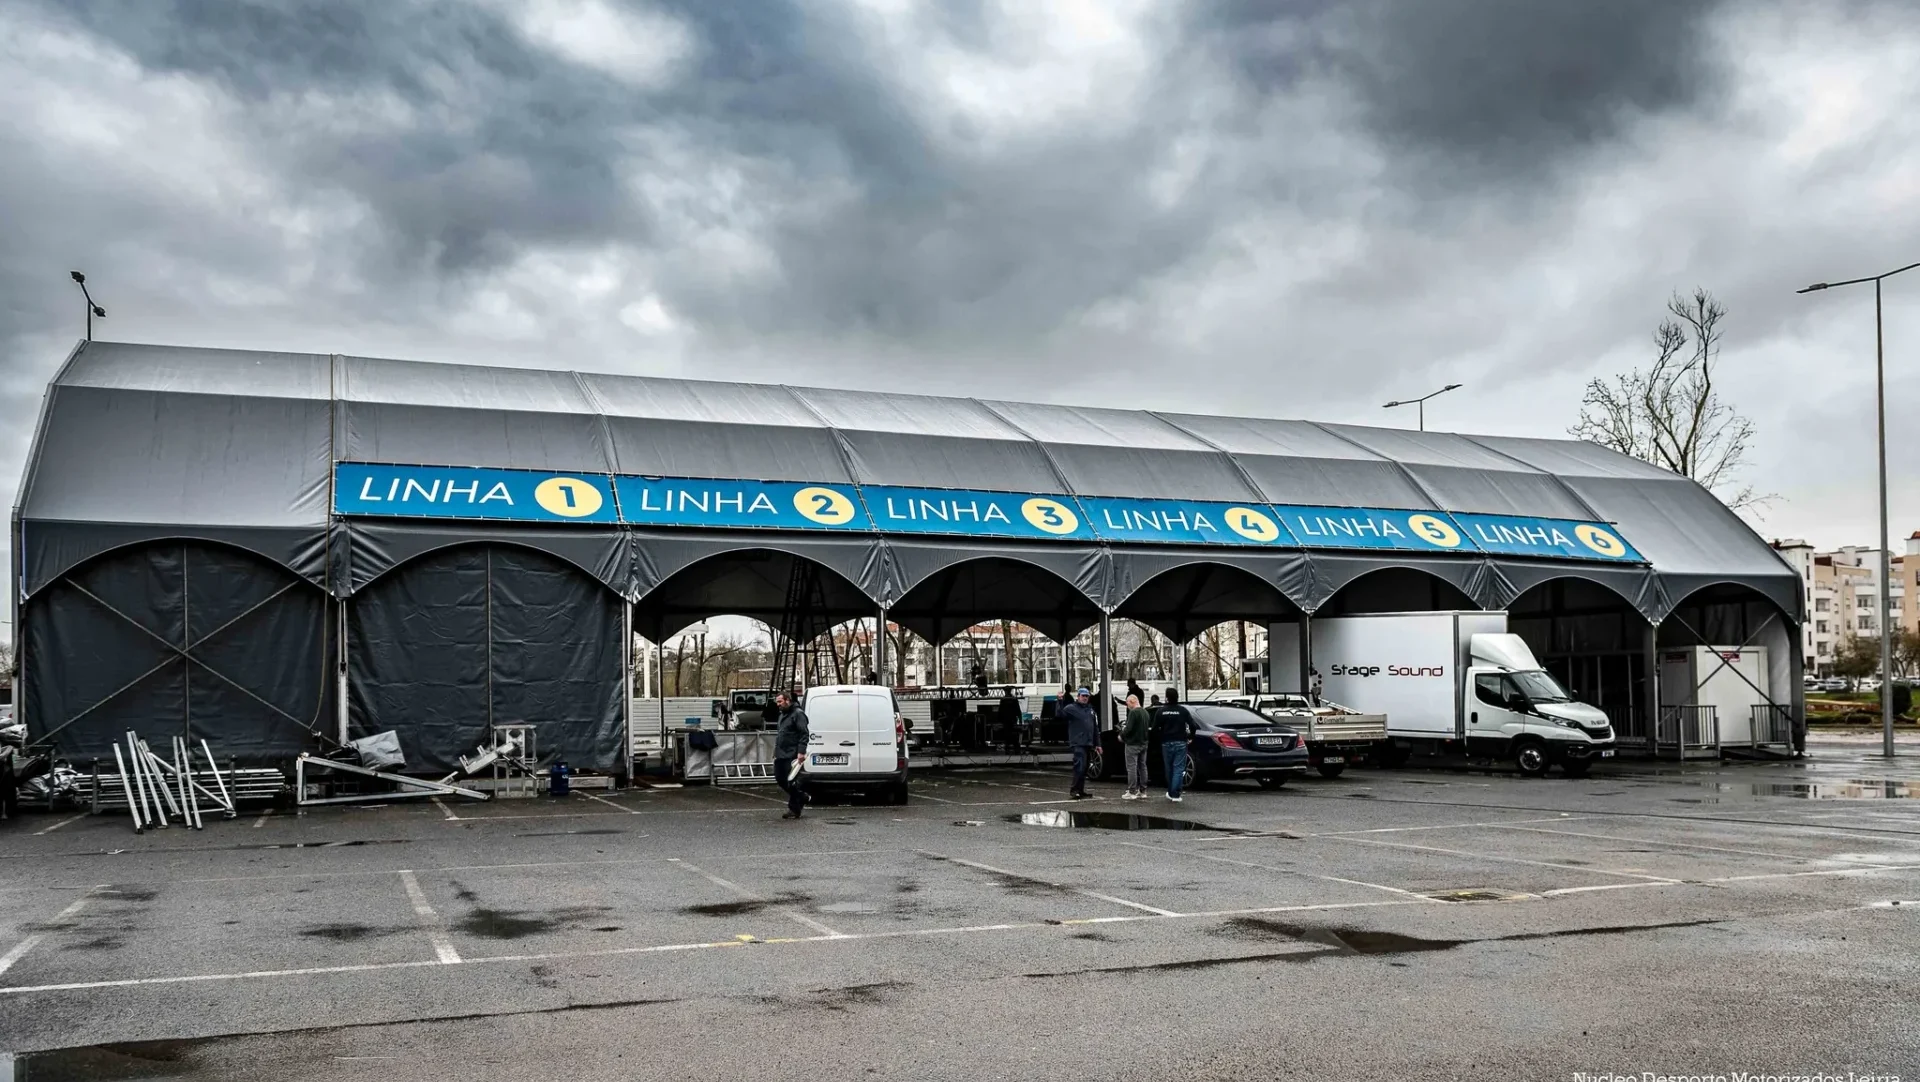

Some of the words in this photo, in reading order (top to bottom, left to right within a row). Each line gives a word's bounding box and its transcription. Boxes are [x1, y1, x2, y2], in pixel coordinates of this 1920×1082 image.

[359, 477, 514, 505] LINHA
[558, 485, 576, 508] 1
[641, 488, 778, 515] LINHA
[811, 494, 839, 516] 2
[887, 498, 1010, 524] LINHA
[1036, 506, 1063, 527] 3
[1104, 509, 1217, 532] LINHA
[1240, 514, 1265, 534] 4
[1298, 516, 1406, 538] LINHA
[1422, 521, 1446, 540] 5
[1476, 523, 1575, 548] LINHA
[1590, 532, 1612, 549] 6
[1331, 664, 1380, 677] Stage
[1388, 665, 1444, 677] Sound
